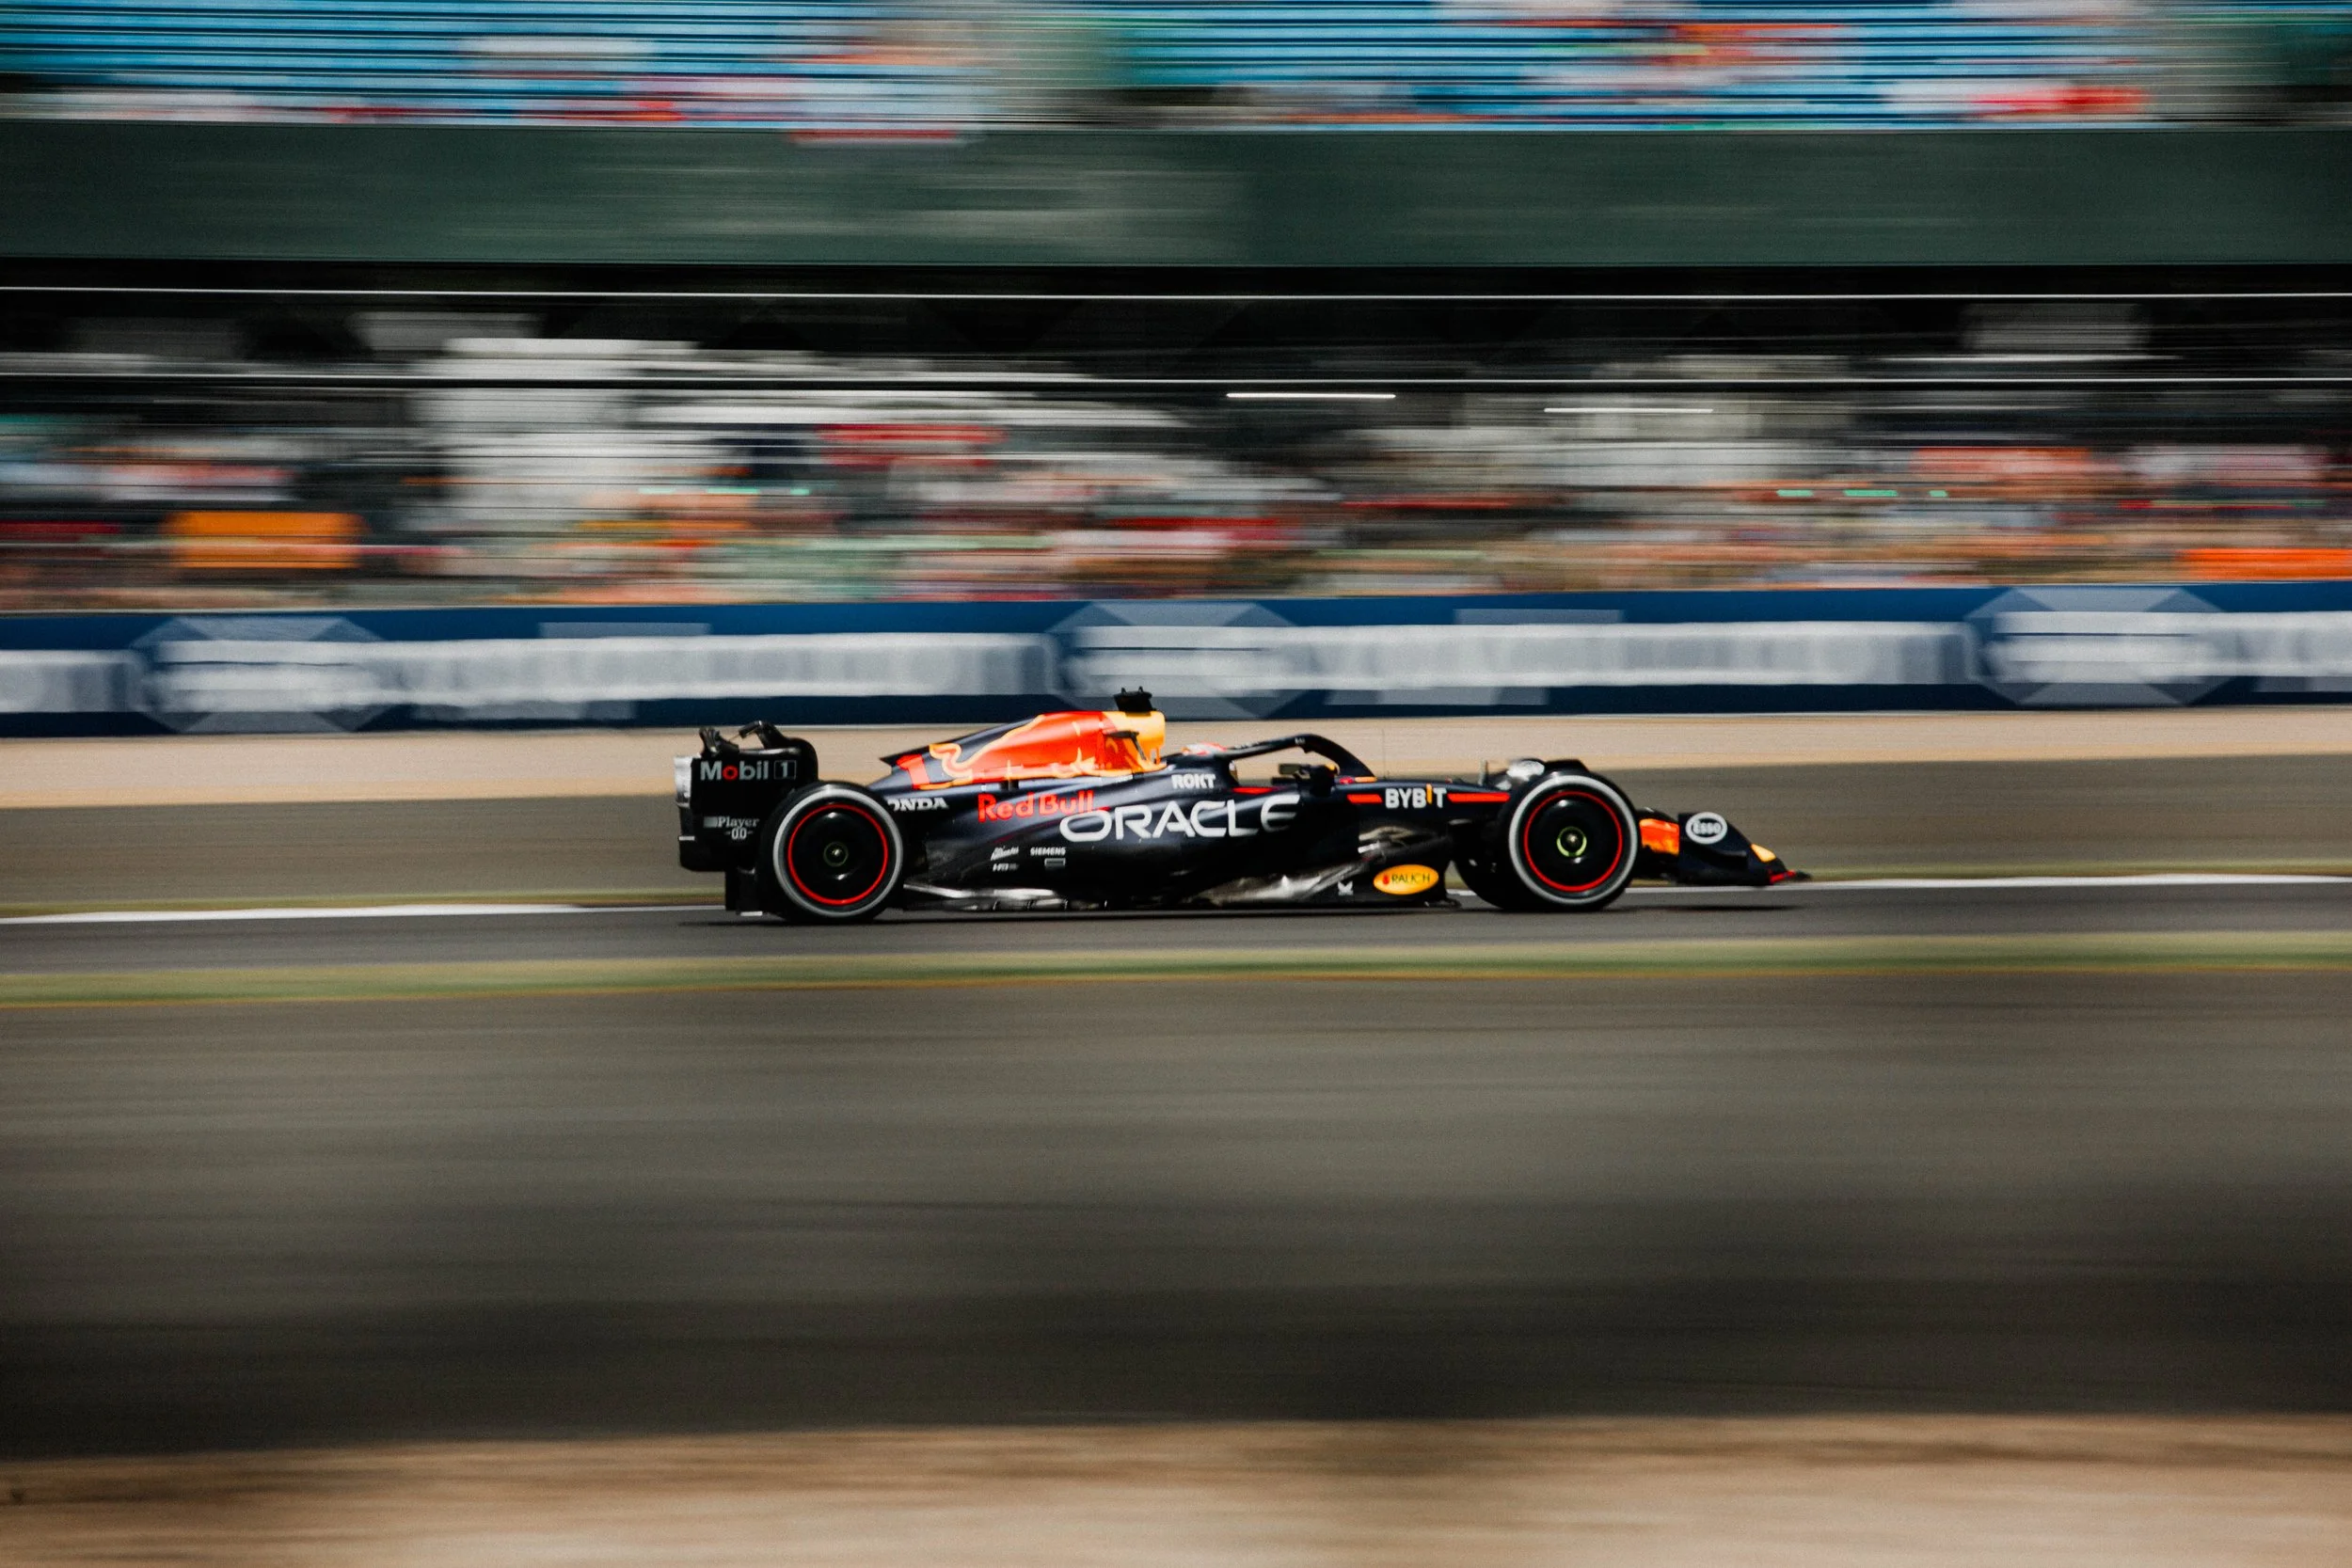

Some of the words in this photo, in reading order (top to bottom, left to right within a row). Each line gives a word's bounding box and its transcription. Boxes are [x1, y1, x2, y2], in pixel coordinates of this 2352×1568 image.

[700, 760, 769, 780] Mobil
[1171, 774, 1216, 789] ROKT
[977, 792, 1035, 823] Red
[1039, 789, 1094, 816] Bull
[1385, 783, 1447, 808] BYBIT
[717, 816, 760, 829] Player
[1059, 794, 1300, 842] ORACLE
